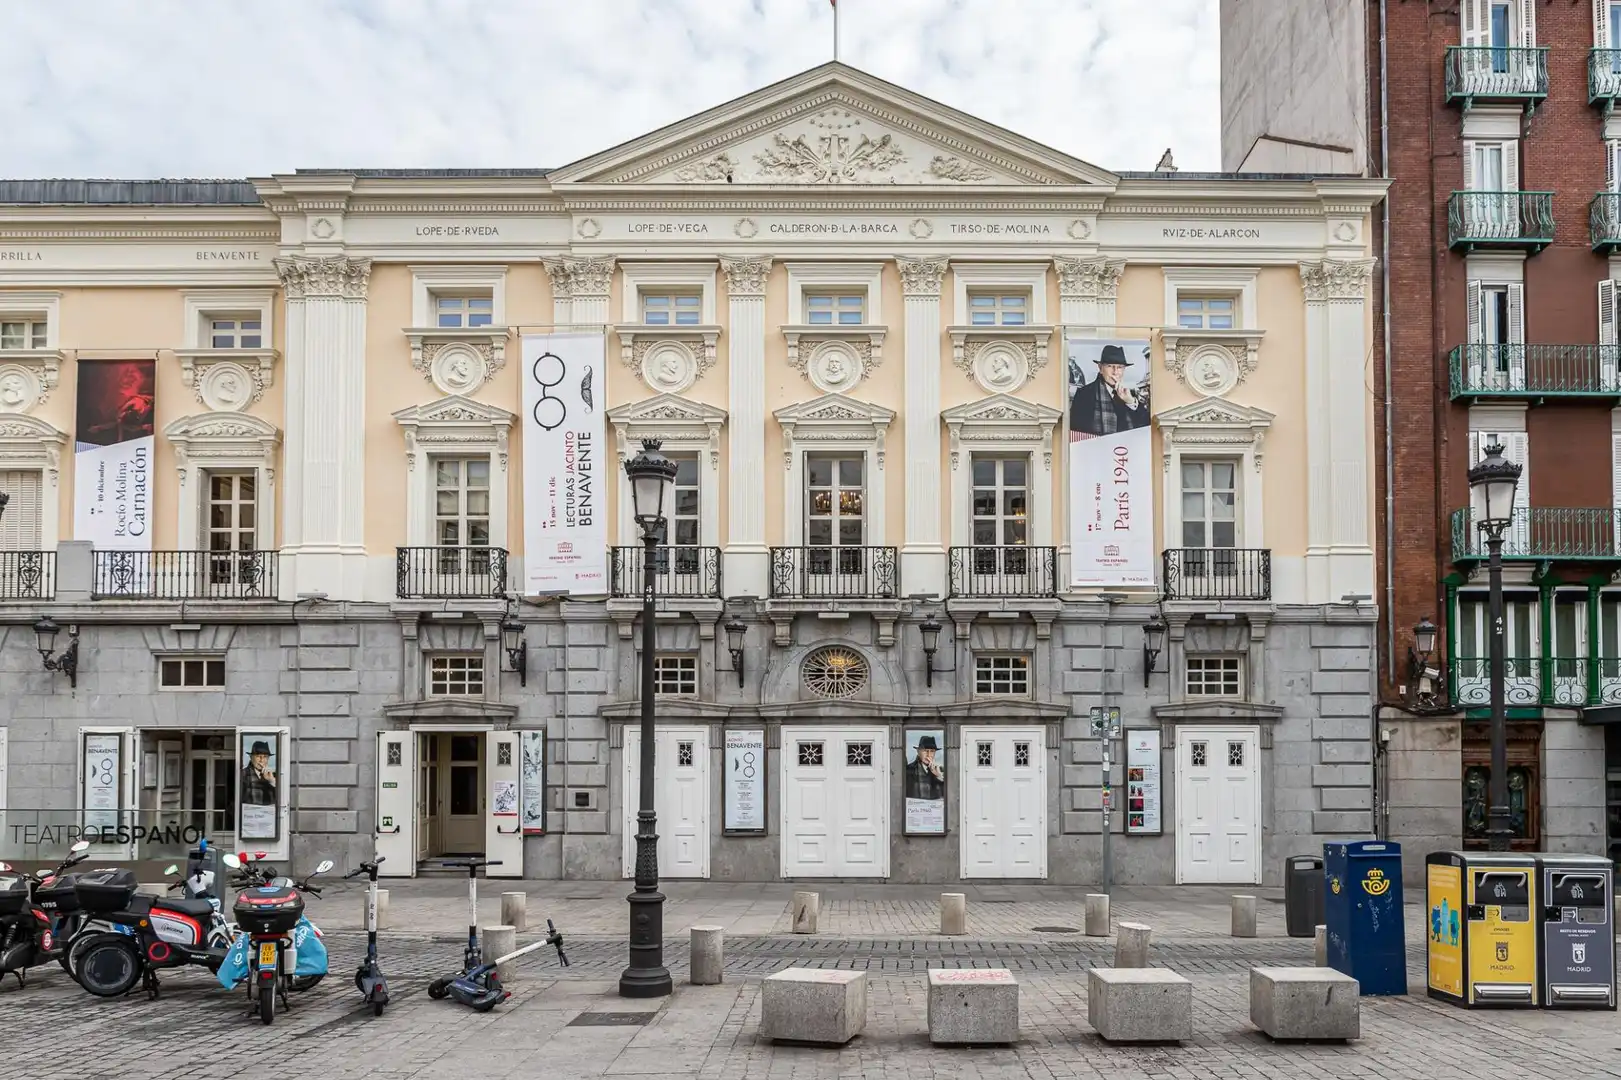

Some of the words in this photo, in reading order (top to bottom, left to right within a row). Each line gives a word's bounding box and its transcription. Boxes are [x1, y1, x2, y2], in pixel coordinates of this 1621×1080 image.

[196, 251, 260, 260] BENAVENTE
[565, 431, 575, 475] JACINTO
[1113, 446, 1129, 485] 1940
[97, 461, 105, 493] diciembre
[116, 462, 127, 501] Molina
[128, 446, 146, 537] Carnación
[548, 476, 556, 487] dic
[578, 432, 592, 526] BENAVENTE
[114, 505, 126, 537] Rocío
[566, 477, 575, 528] LECTURAS
[1113, 492, 1129, 531] París
[549, 520, 556, 528] 15
